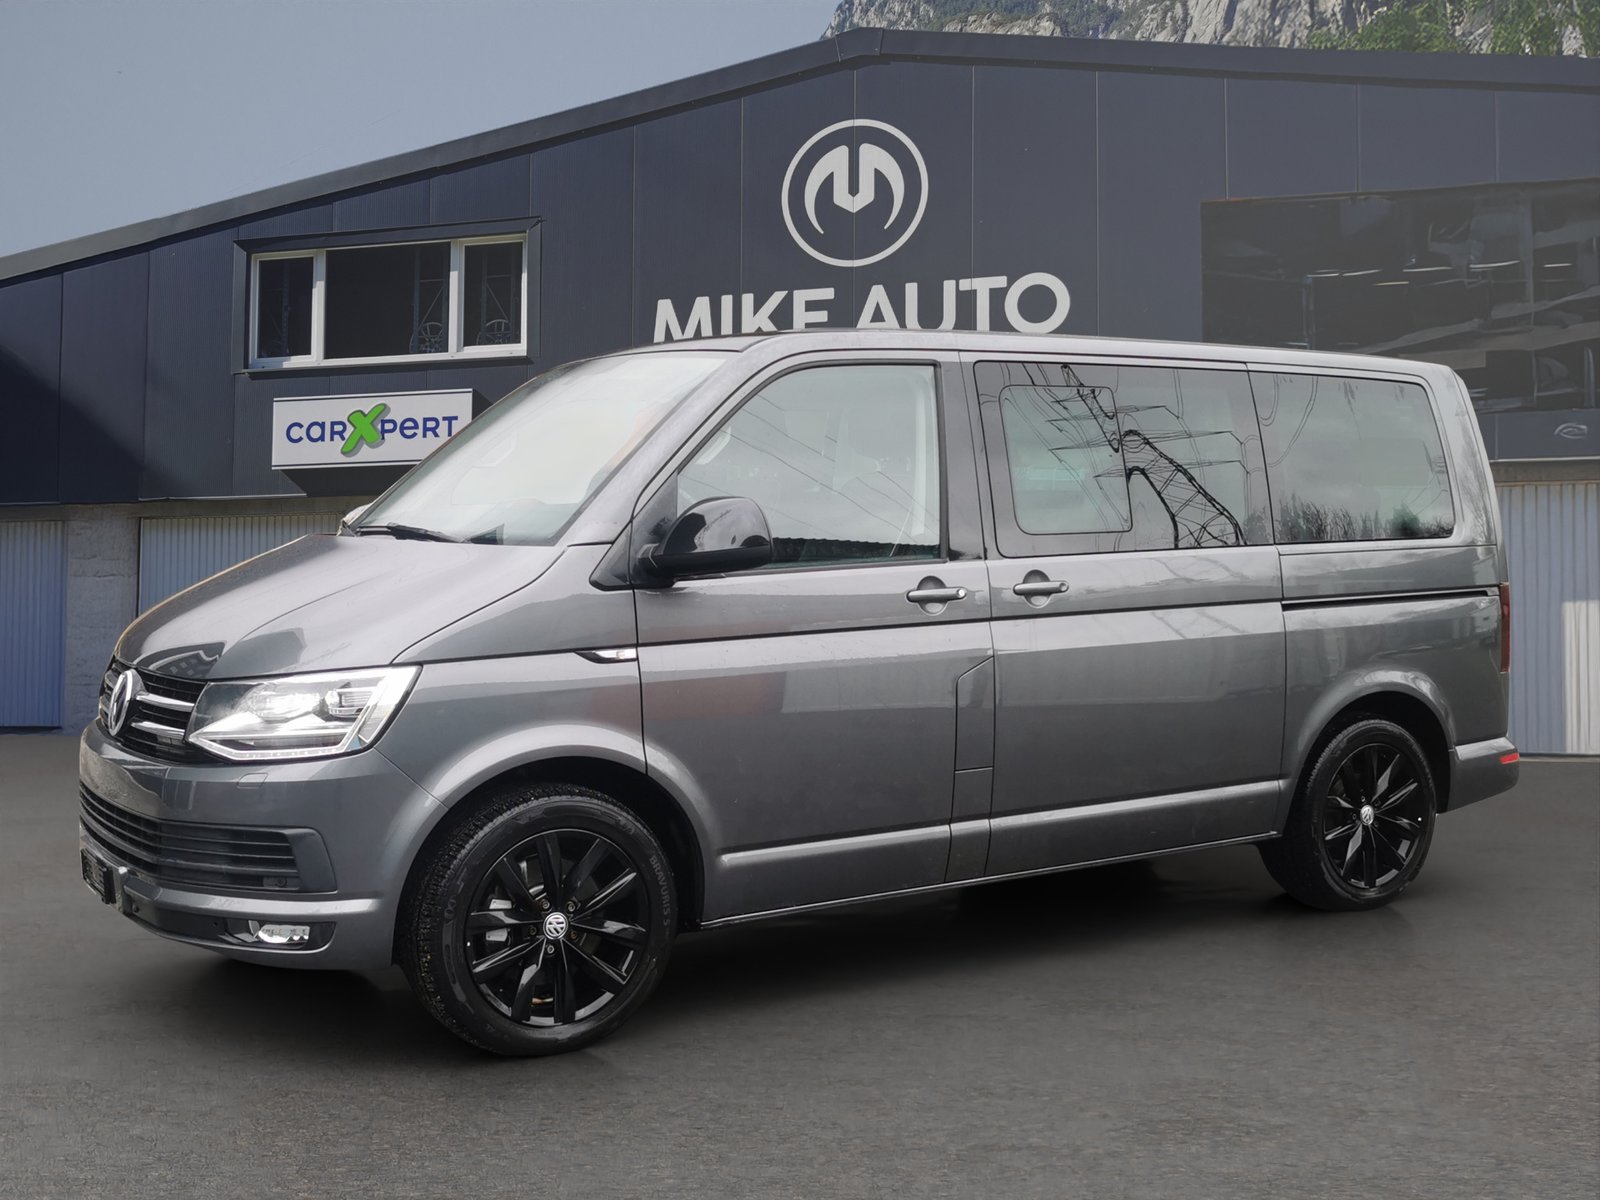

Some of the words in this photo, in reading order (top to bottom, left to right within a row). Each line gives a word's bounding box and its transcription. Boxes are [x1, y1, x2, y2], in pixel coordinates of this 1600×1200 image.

[653, 287, 835, 344] MIKE
[856, 272, 1071, 334] AUTO
[649, 855, 671, 916] BRAVURIS
